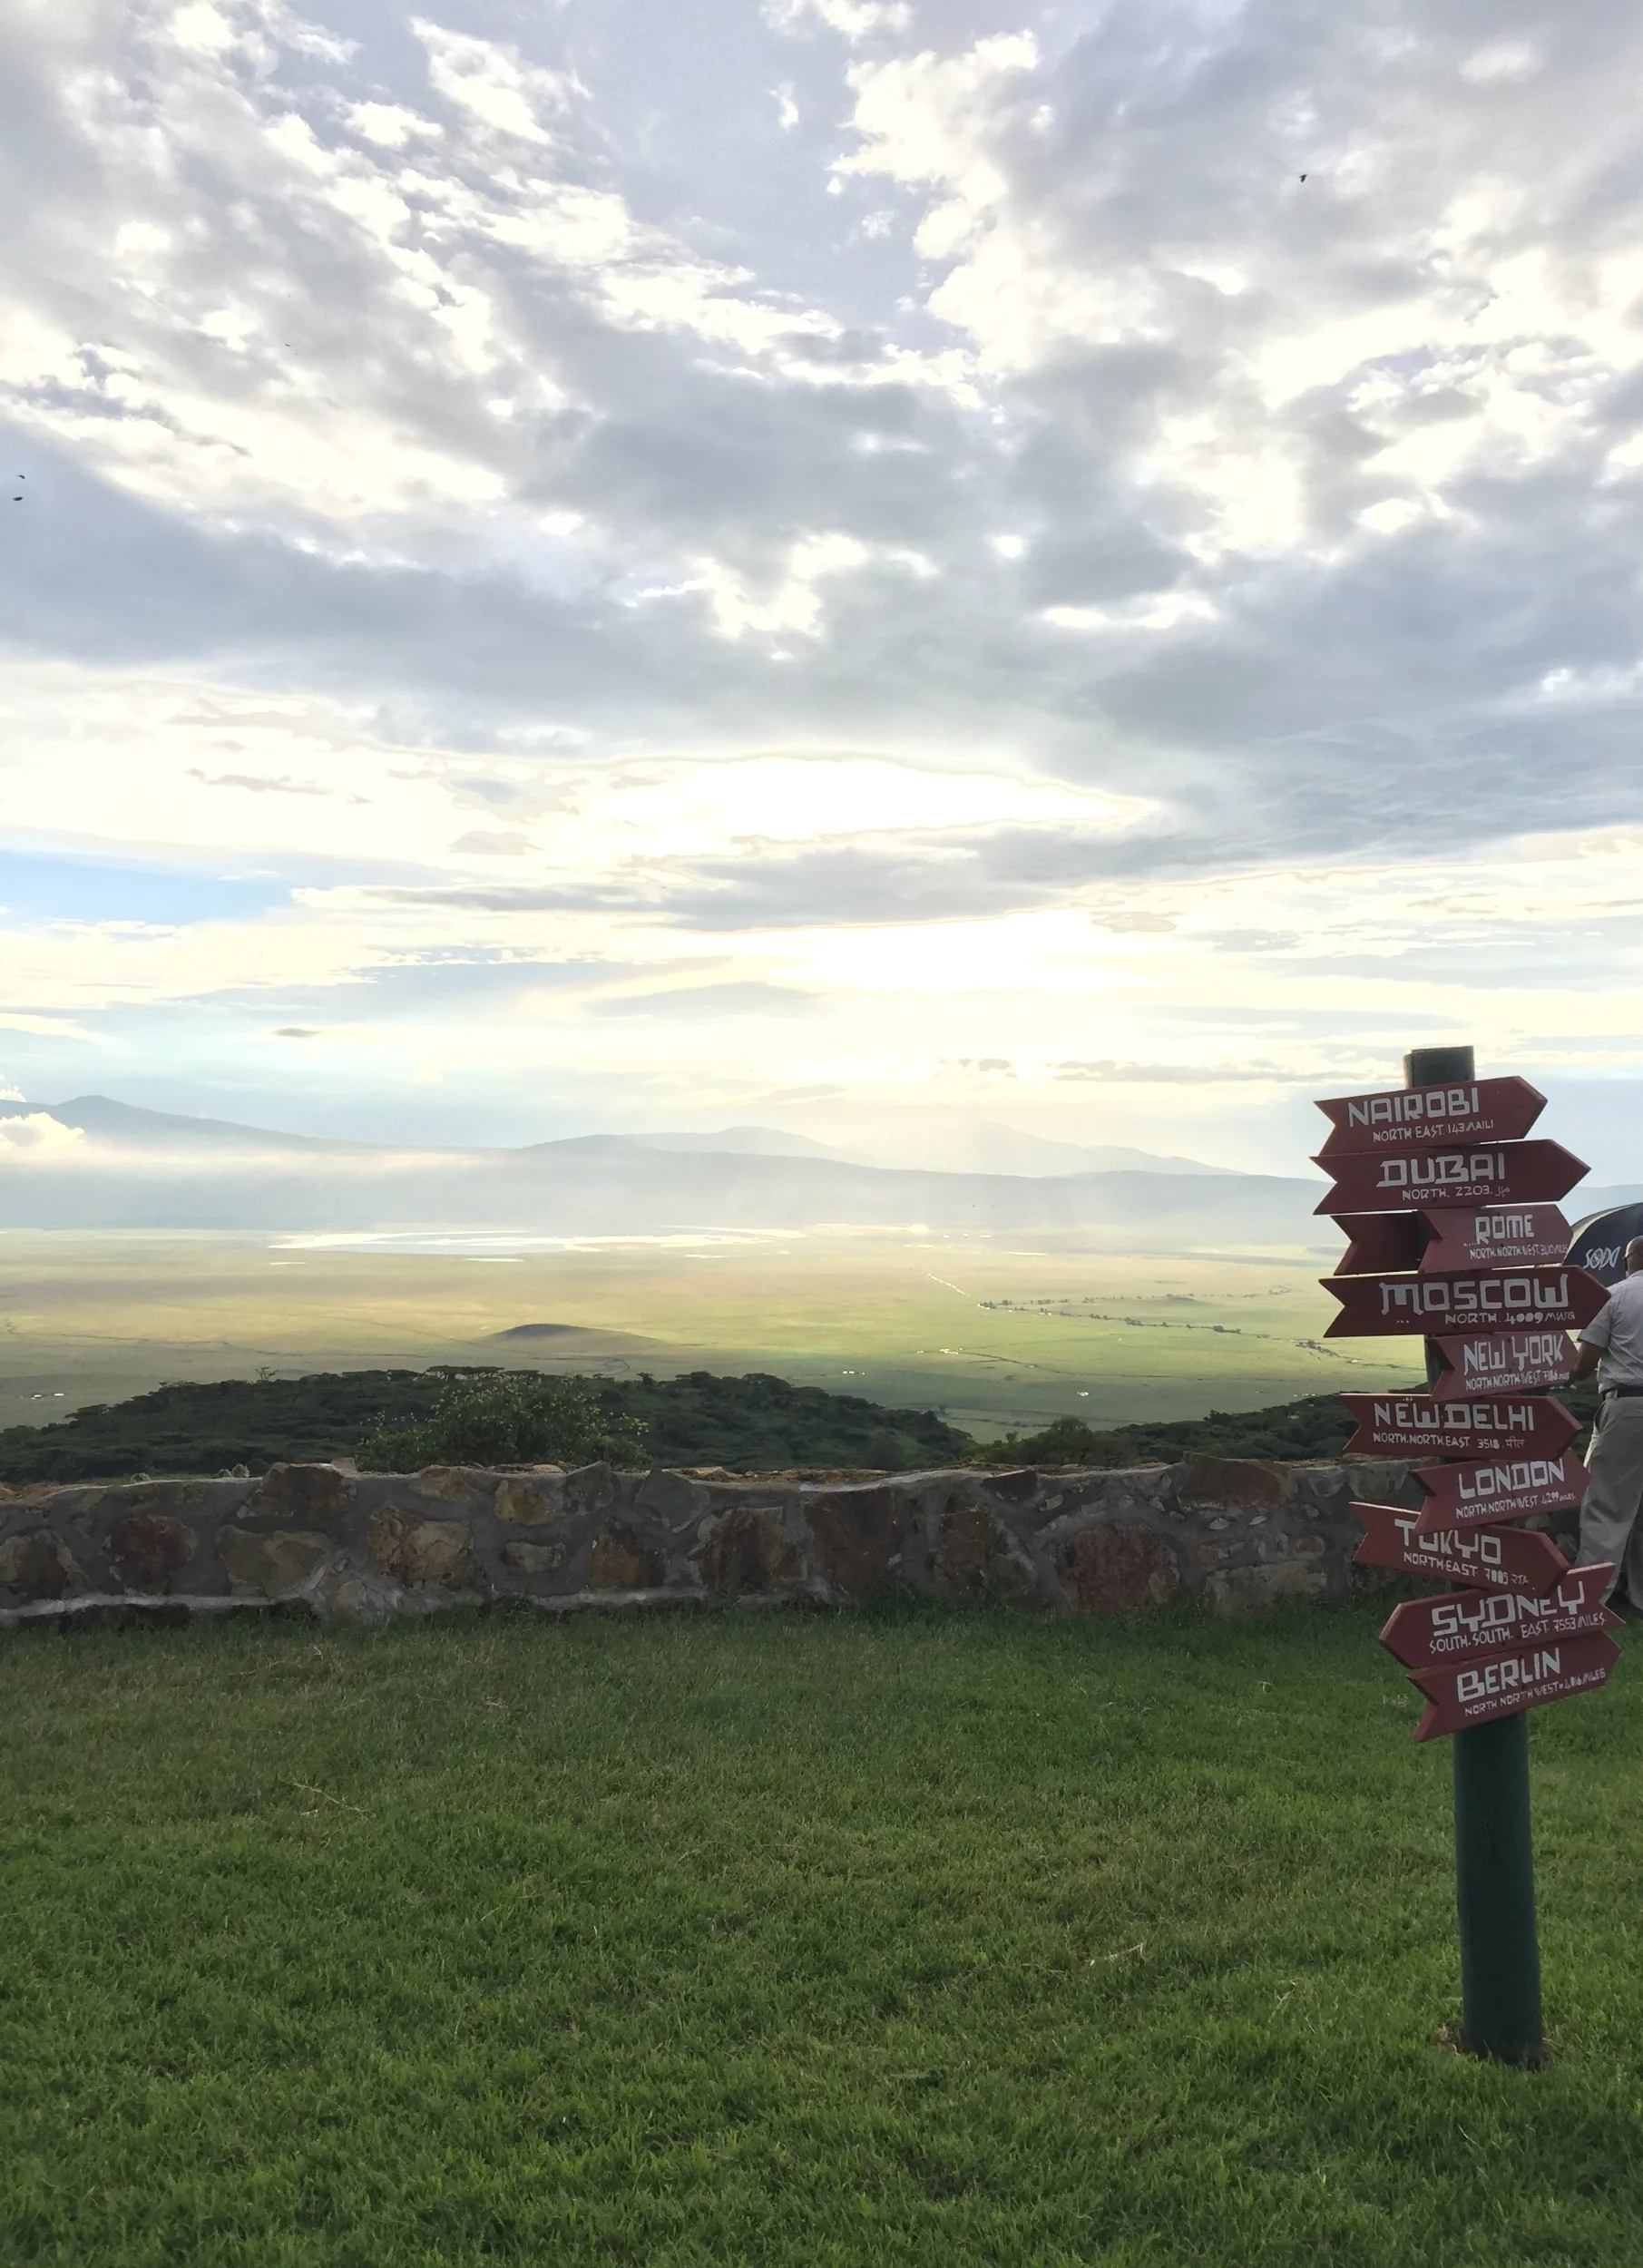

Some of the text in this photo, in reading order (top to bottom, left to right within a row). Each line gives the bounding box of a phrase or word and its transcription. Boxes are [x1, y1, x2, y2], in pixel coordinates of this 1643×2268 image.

[1348, 1087, 1480, 1128] NAIROBI
[1373, 1127, 1413, 1143] NORTH
[1376, 1153, 1506, 1188] DUBAI
[1474, 1215, 1535, 1246] ROME
[1379, 1274, 1569, 1315] MOSCOW
[1463, 1334, 1564, 1375] NEW YORK
[1374, 1403, 1534, 1431] NEW DELHI
[1458, 1458, 1565, 1500] LONDON
[1431, 1580, 1585, 1637] SYDNEY
[1456, 1647, 1561, 1703] BERLIN
[1464, 1701, 1498, 1717] NORTH
[1501, 1687, 1533, 1706] NORTH
